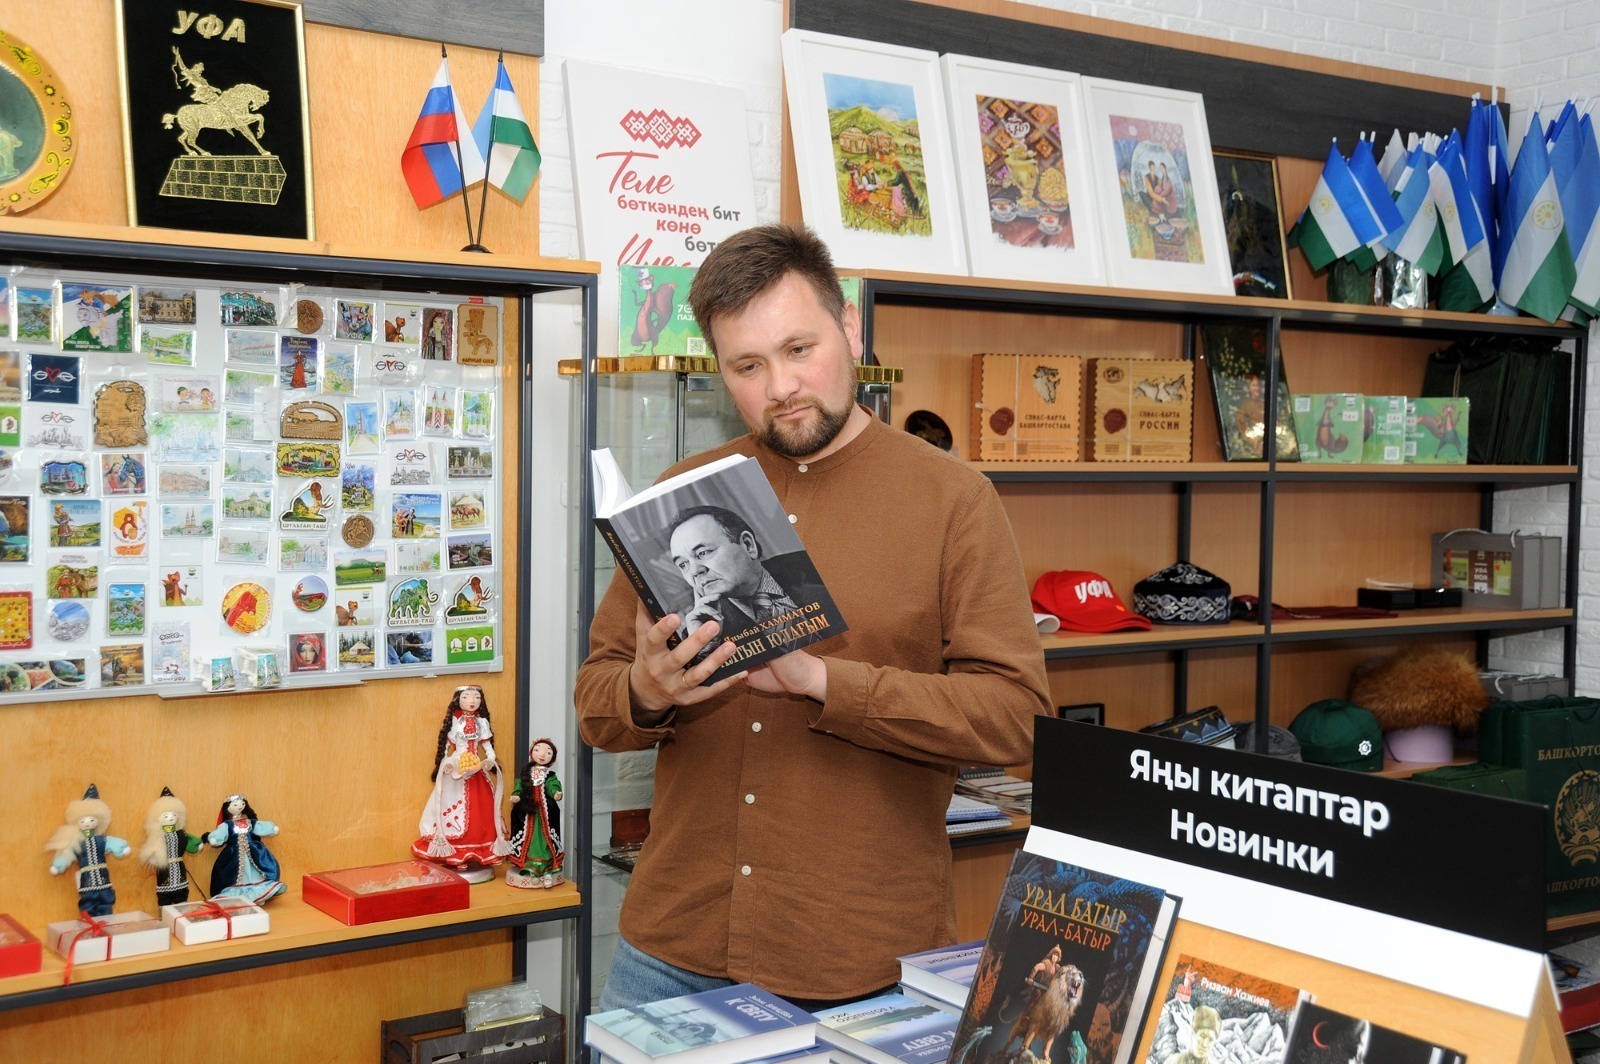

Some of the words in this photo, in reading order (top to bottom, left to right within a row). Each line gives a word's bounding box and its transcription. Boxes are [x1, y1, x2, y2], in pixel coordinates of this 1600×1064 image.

[172, 10, 247, 43] УФА
[595, 150, 675, 195] Теле
[713, 205, 741, 222] бит
[656, 217, 702, 235] көнө
[684, 235, 719, 252] бөт
[345, 331, 364, 340] УФА
[1139, 420, 1180, 430] РОССИИ
[448, 615, 488, 623] ШУЛЬГАН-ТАШ
[759, 601, 821, 630] ХАММАТОВ
[1129, 748, 1199, 793] Яңы
[1210, 770, 1390, 838] китаптар
[1169, 808, 1335, 878] Новинки
[1022, 882, 1065, 916] УРАЛ
[1071, 897, 1128, 931] БАТЫР
[1020, 908, 1112, 952] УРАЛ-БАТЫР
[1200, 977, 1233, 996] Ризван
[736, 1003, 779, 1022] СВЕТУ
[901, 1034, 946, 1051] СВЕТУ
